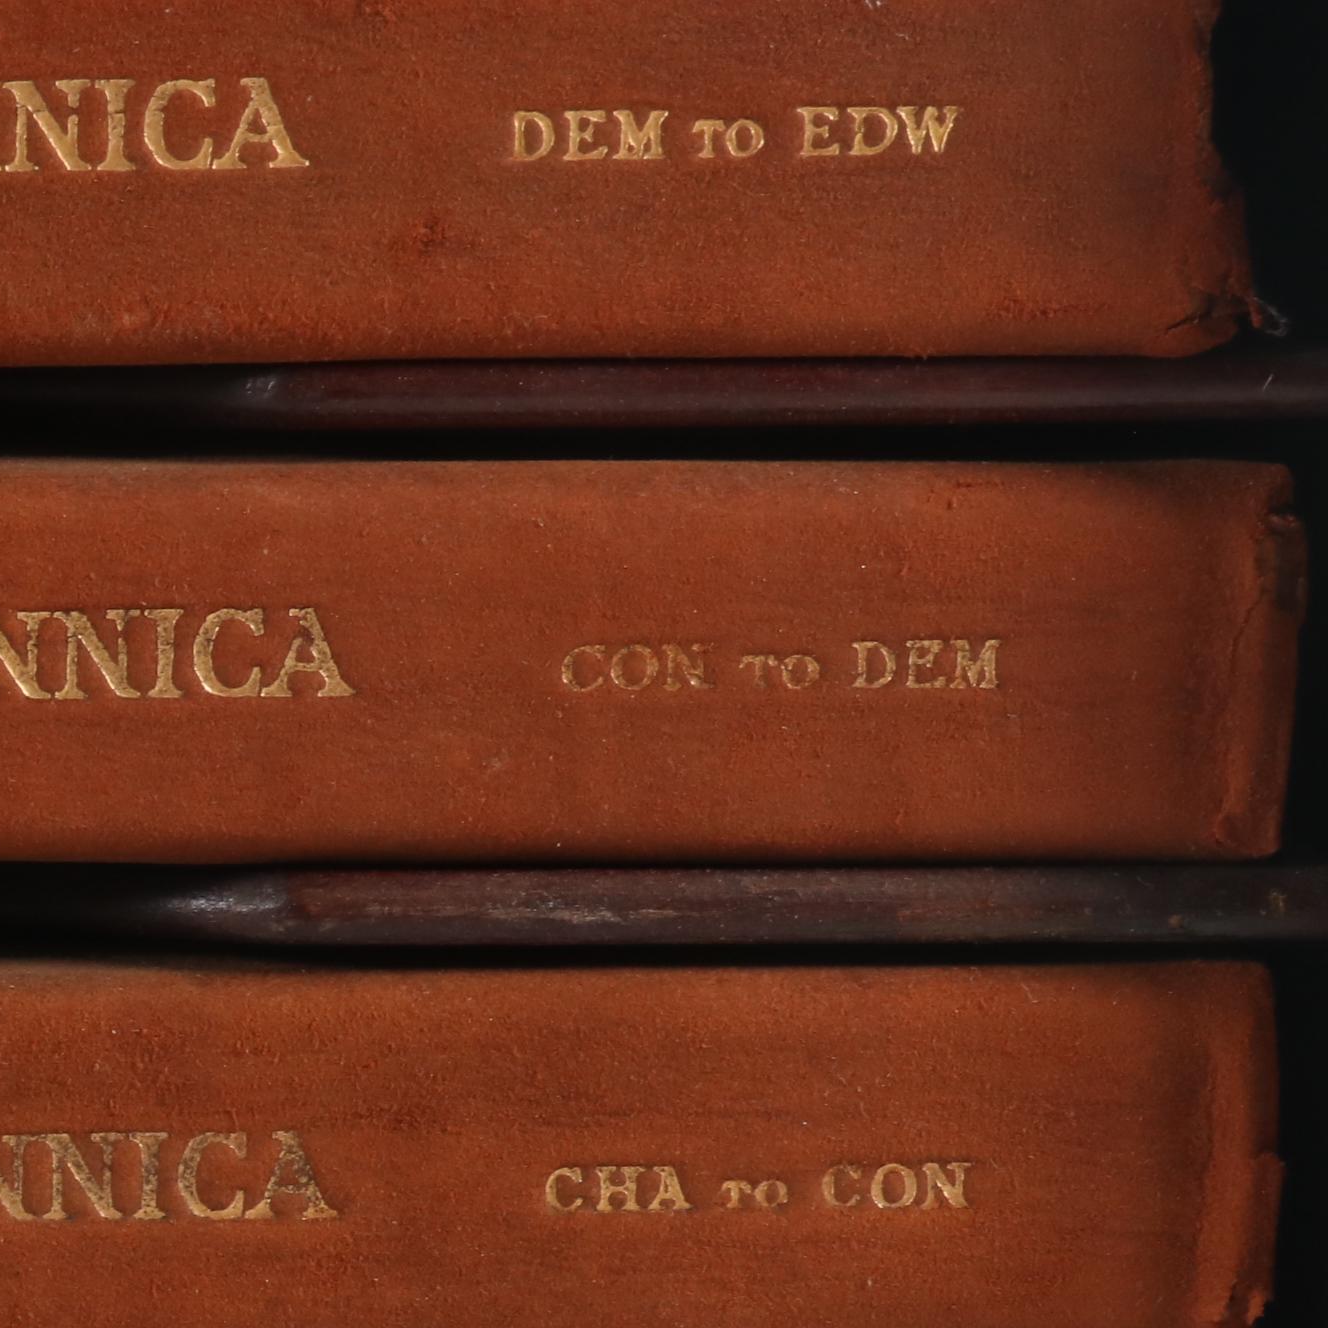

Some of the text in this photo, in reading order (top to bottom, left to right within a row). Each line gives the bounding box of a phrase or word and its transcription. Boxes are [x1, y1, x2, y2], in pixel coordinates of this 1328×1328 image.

[511, 110, 669, 162] DEM
[796, 106, 958, 159] EDW
[561, 643, 715, 692] CON
[852, 640, 998, 688] DEM
[545, 1167, 690, 1212] CHA
[822, 1163, 971, 1209] CON
